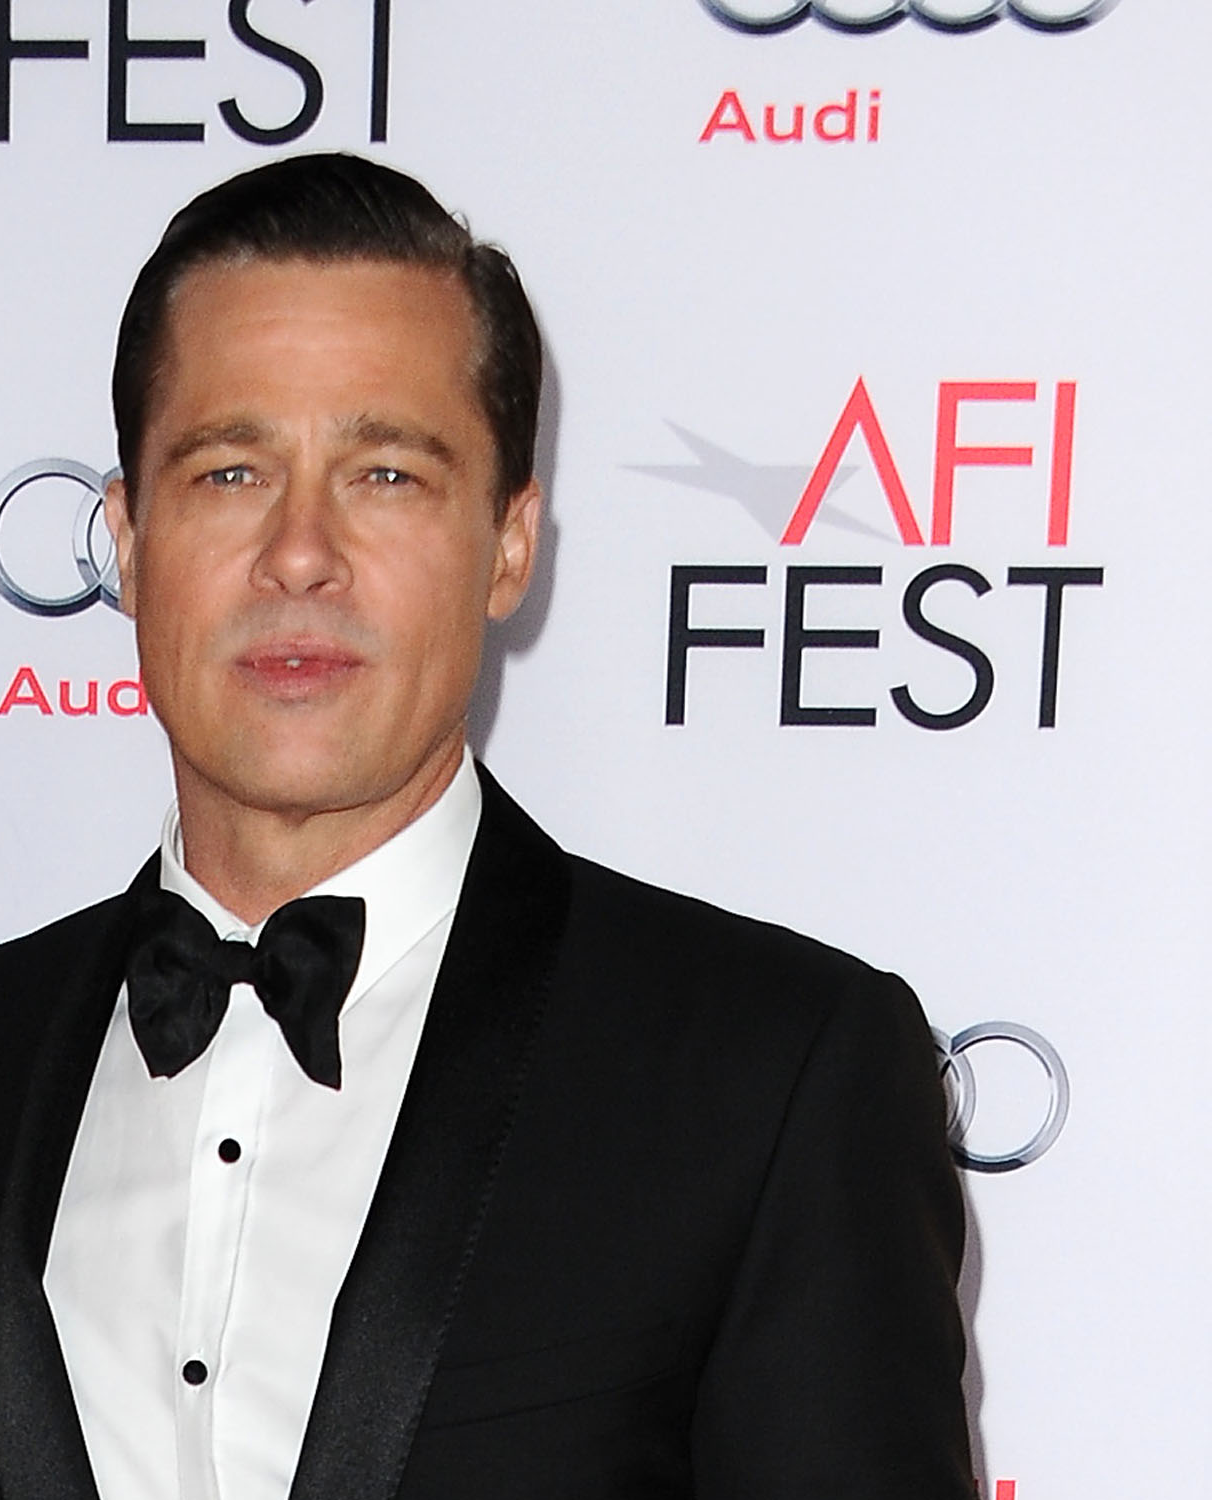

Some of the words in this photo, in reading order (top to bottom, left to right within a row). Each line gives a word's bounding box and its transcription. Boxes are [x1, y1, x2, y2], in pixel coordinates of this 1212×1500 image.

[699, 90, 881, 143] Audi
[779, 375, 1077, 547] AFI
[665, 563, 1104, 731] FEST
